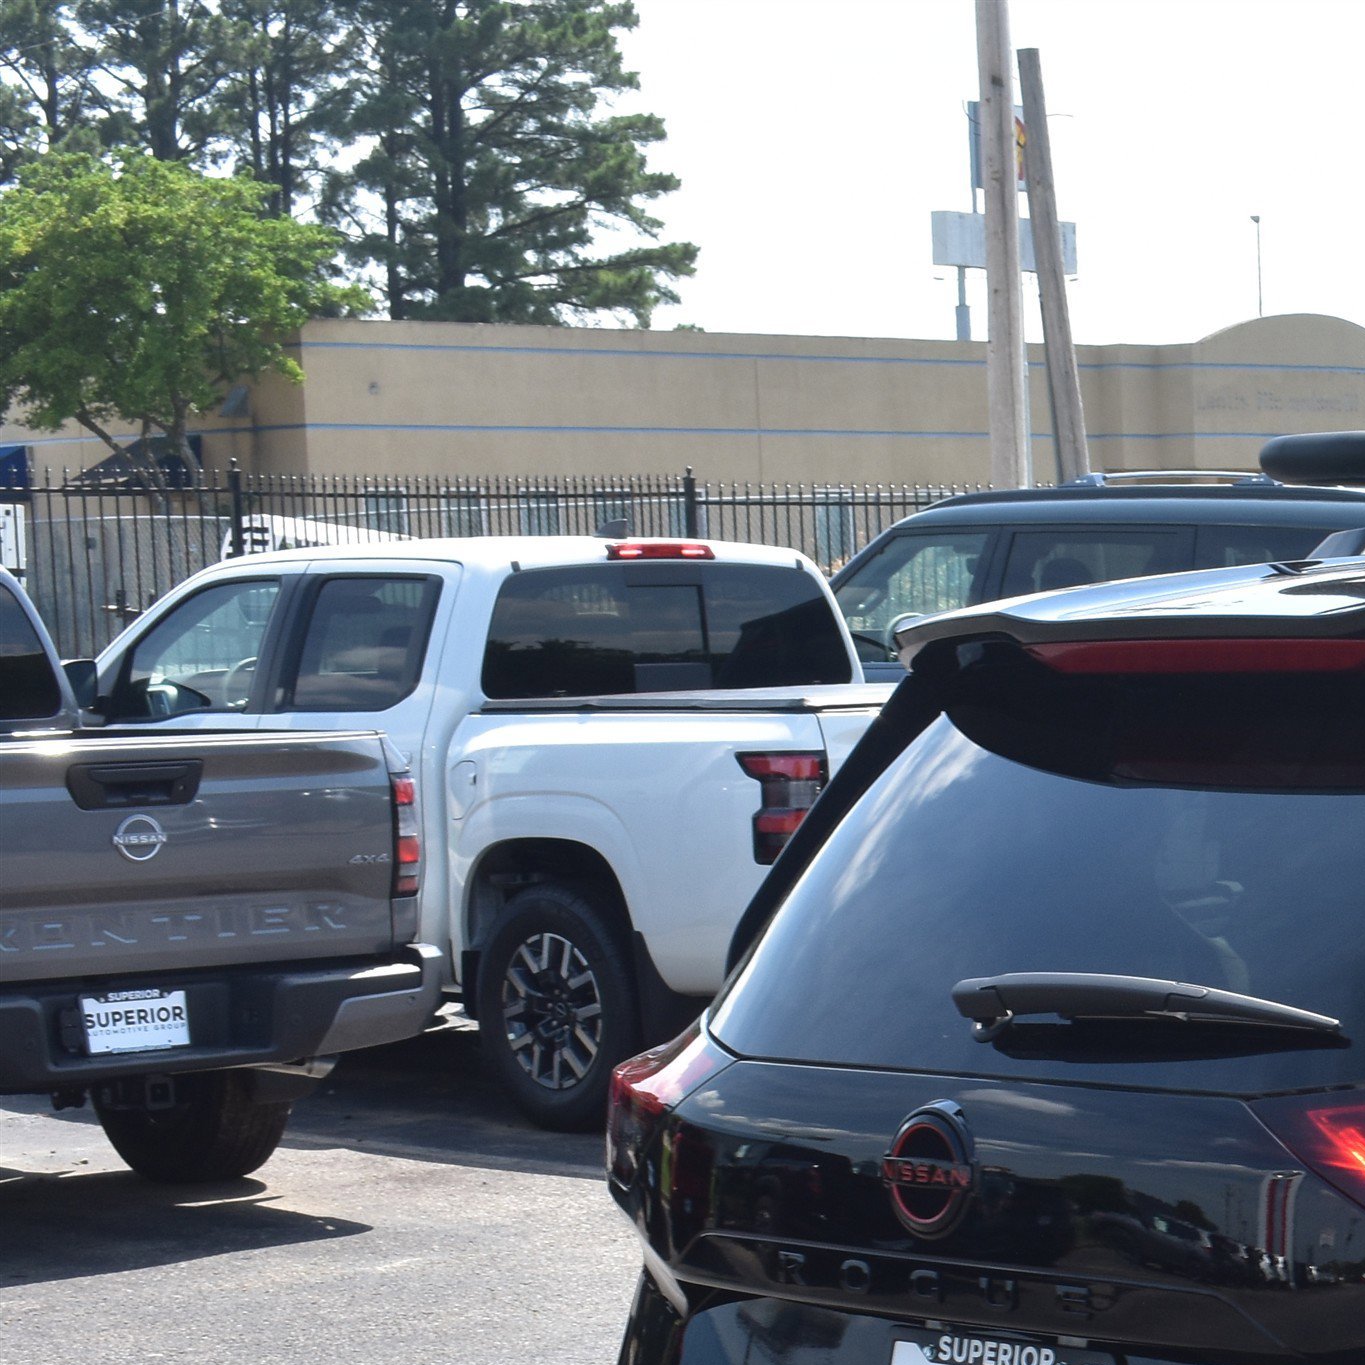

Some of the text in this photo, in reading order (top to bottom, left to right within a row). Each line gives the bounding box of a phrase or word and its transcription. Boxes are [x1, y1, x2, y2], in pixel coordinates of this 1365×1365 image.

[113, 834, 167, 845] NISSAN
[0, 900, 347, 952] ONTIER
[107, 988, 161, 1002] SUPERIOR
[85, 1005, 186, 1029] SUPERIOR
[154, 1022, 186, 1031] GROUP
[777, 1249, 1094, 1321] ROGUE
